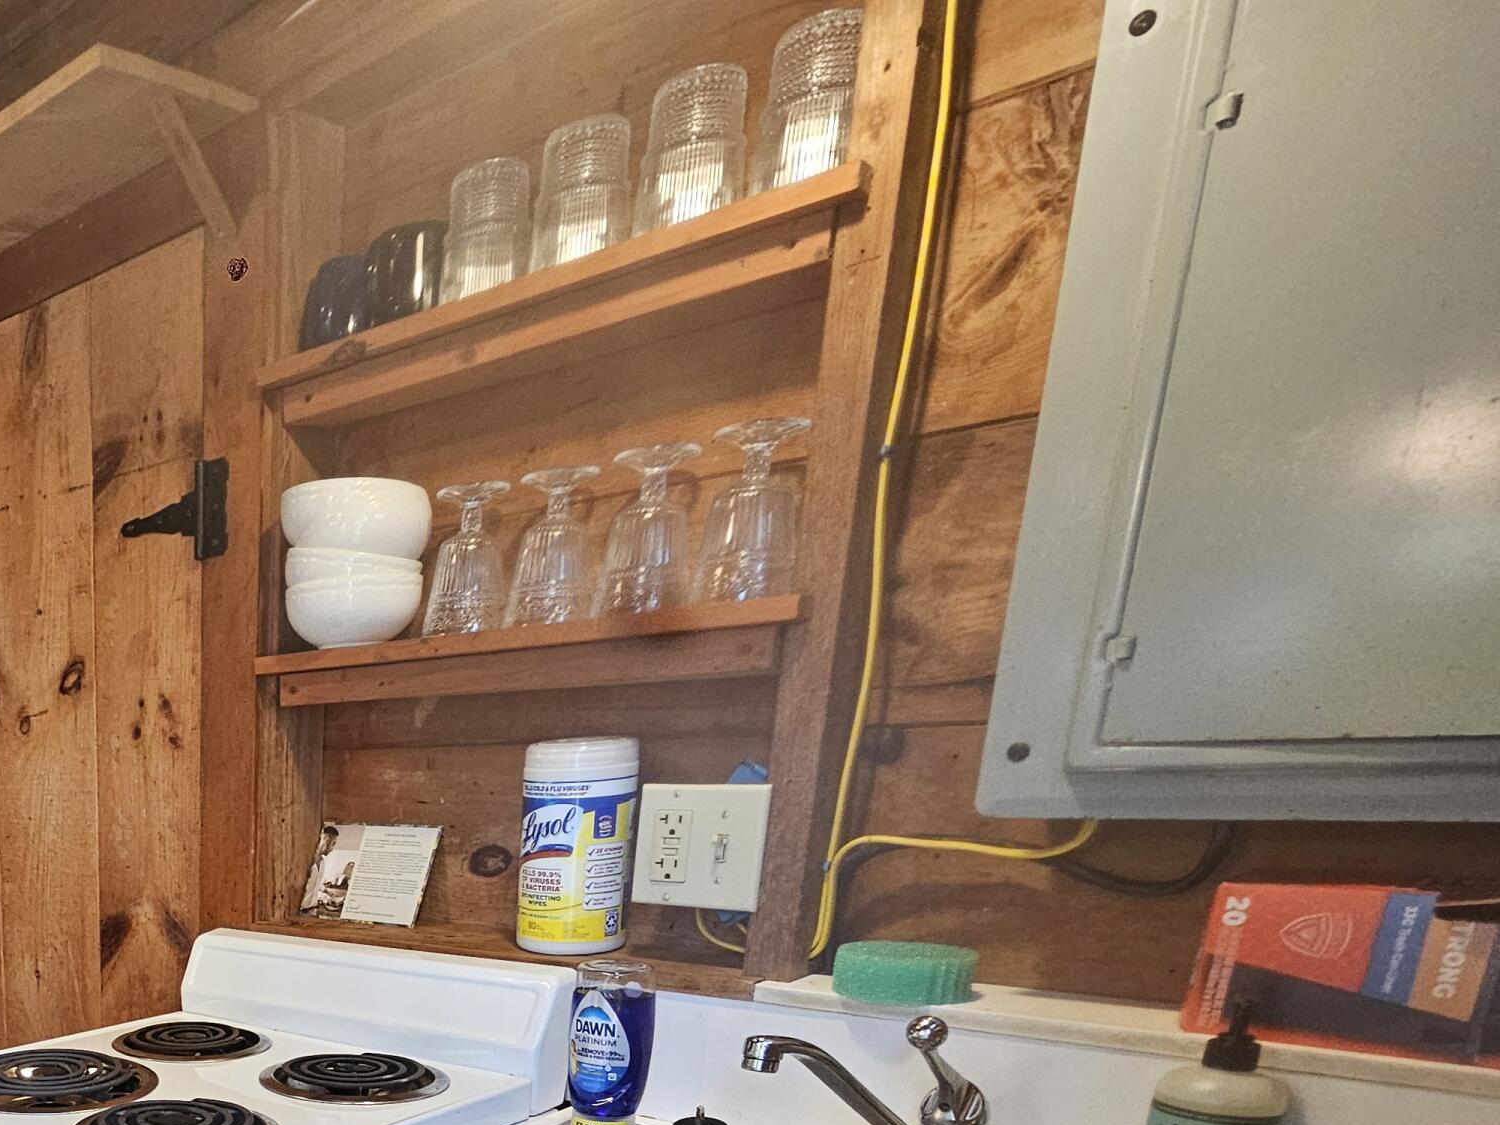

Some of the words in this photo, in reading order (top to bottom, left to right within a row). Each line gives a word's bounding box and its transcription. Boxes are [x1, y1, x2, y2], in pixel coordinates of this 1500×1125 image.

[522, 806, 576, 851] Lysol
[525, 883, 560, 892] BACTERIA
[529, 877, 561, 885] VIRUSES
[1221, 895, 1252, 927] 20
[1430, 920, 1477, 999] TRONG
[575, 1018, 616, 1038] DAWN
[575, 1033, 617, 1047] PLATINUM
